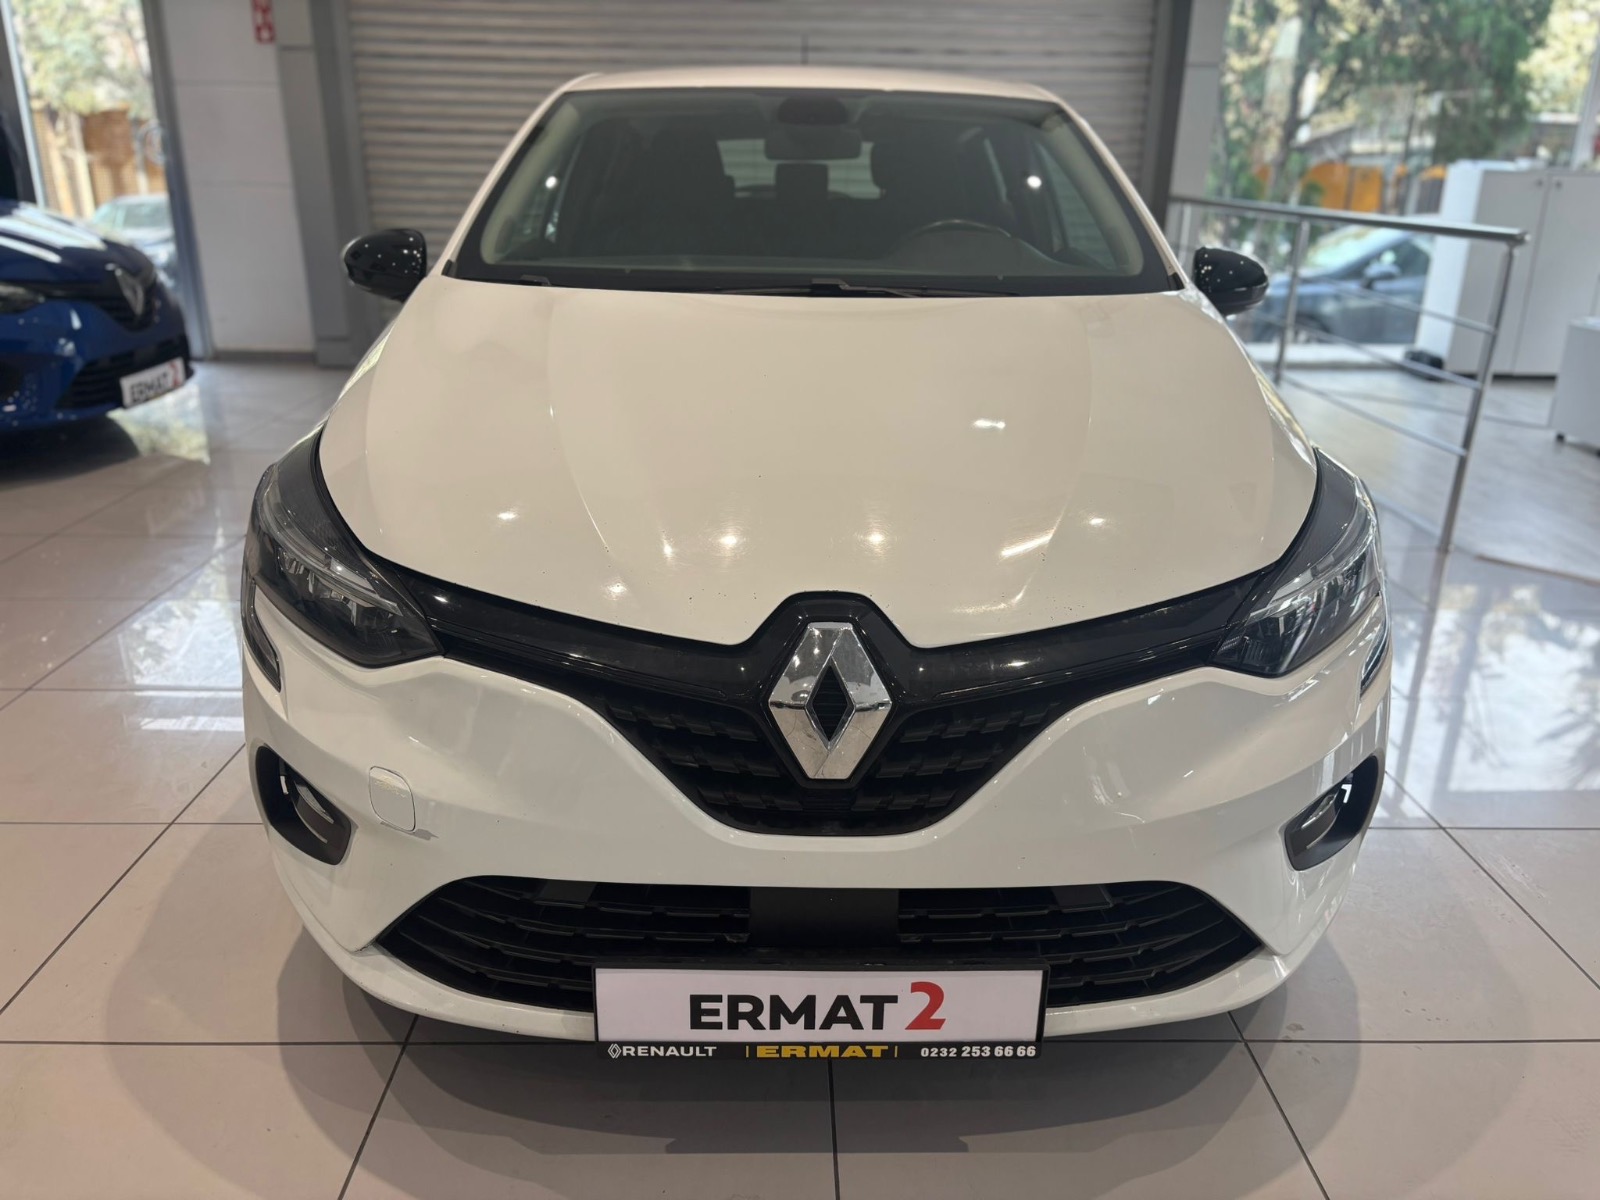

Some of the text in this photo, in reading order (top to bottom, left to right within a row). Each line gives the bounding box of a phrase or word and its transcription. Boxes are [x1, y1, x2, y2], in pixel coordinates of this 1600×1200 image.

[689, 981, 947, 1030] ERMAT 2
[622, 1046, 718, 1057] RENAULT
[756, 1045, 889, 1058] ERMAT
[920, 1046, 1037, 1058] 0232 253 66 66
